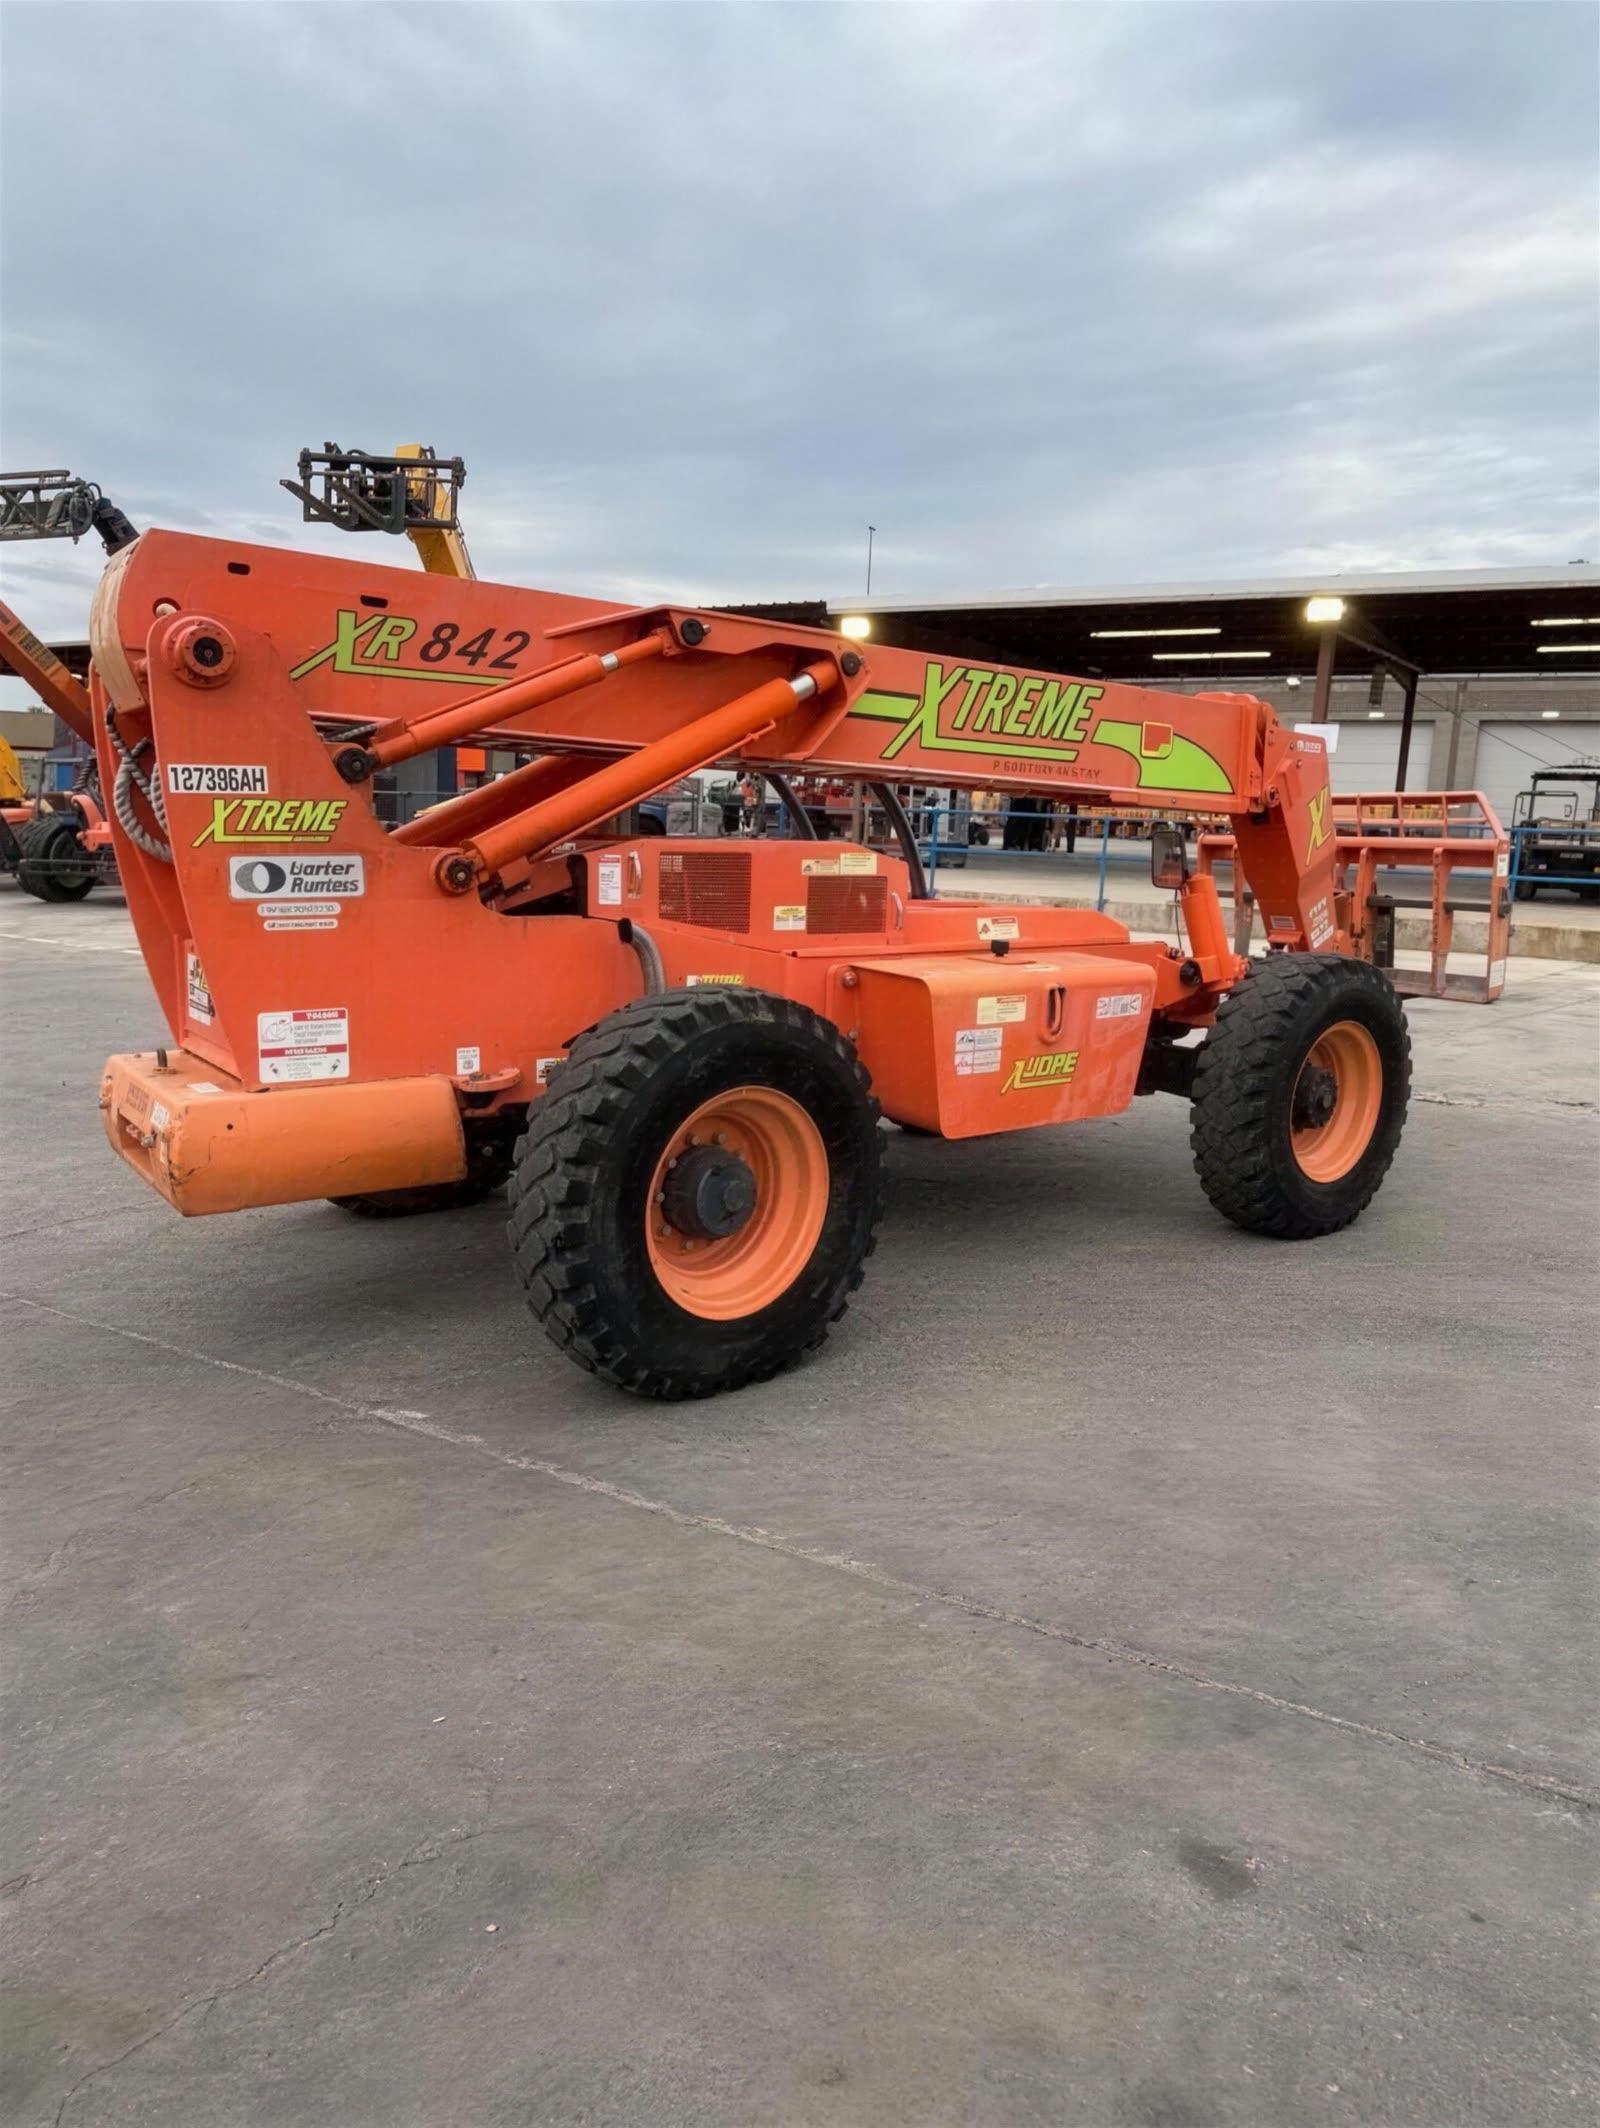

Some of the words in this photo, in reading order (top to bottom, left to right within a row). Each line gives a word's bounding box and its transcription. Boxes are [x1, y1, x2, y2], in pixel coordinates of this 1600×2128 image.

[289, 609, 418, 681] XR
[419, 622, 531, 670] 842
[880, 661, 1105, 760] XTREME
[170, 766, 266, 792] 127396AH
[191, 798, 348, 848] XTREME
